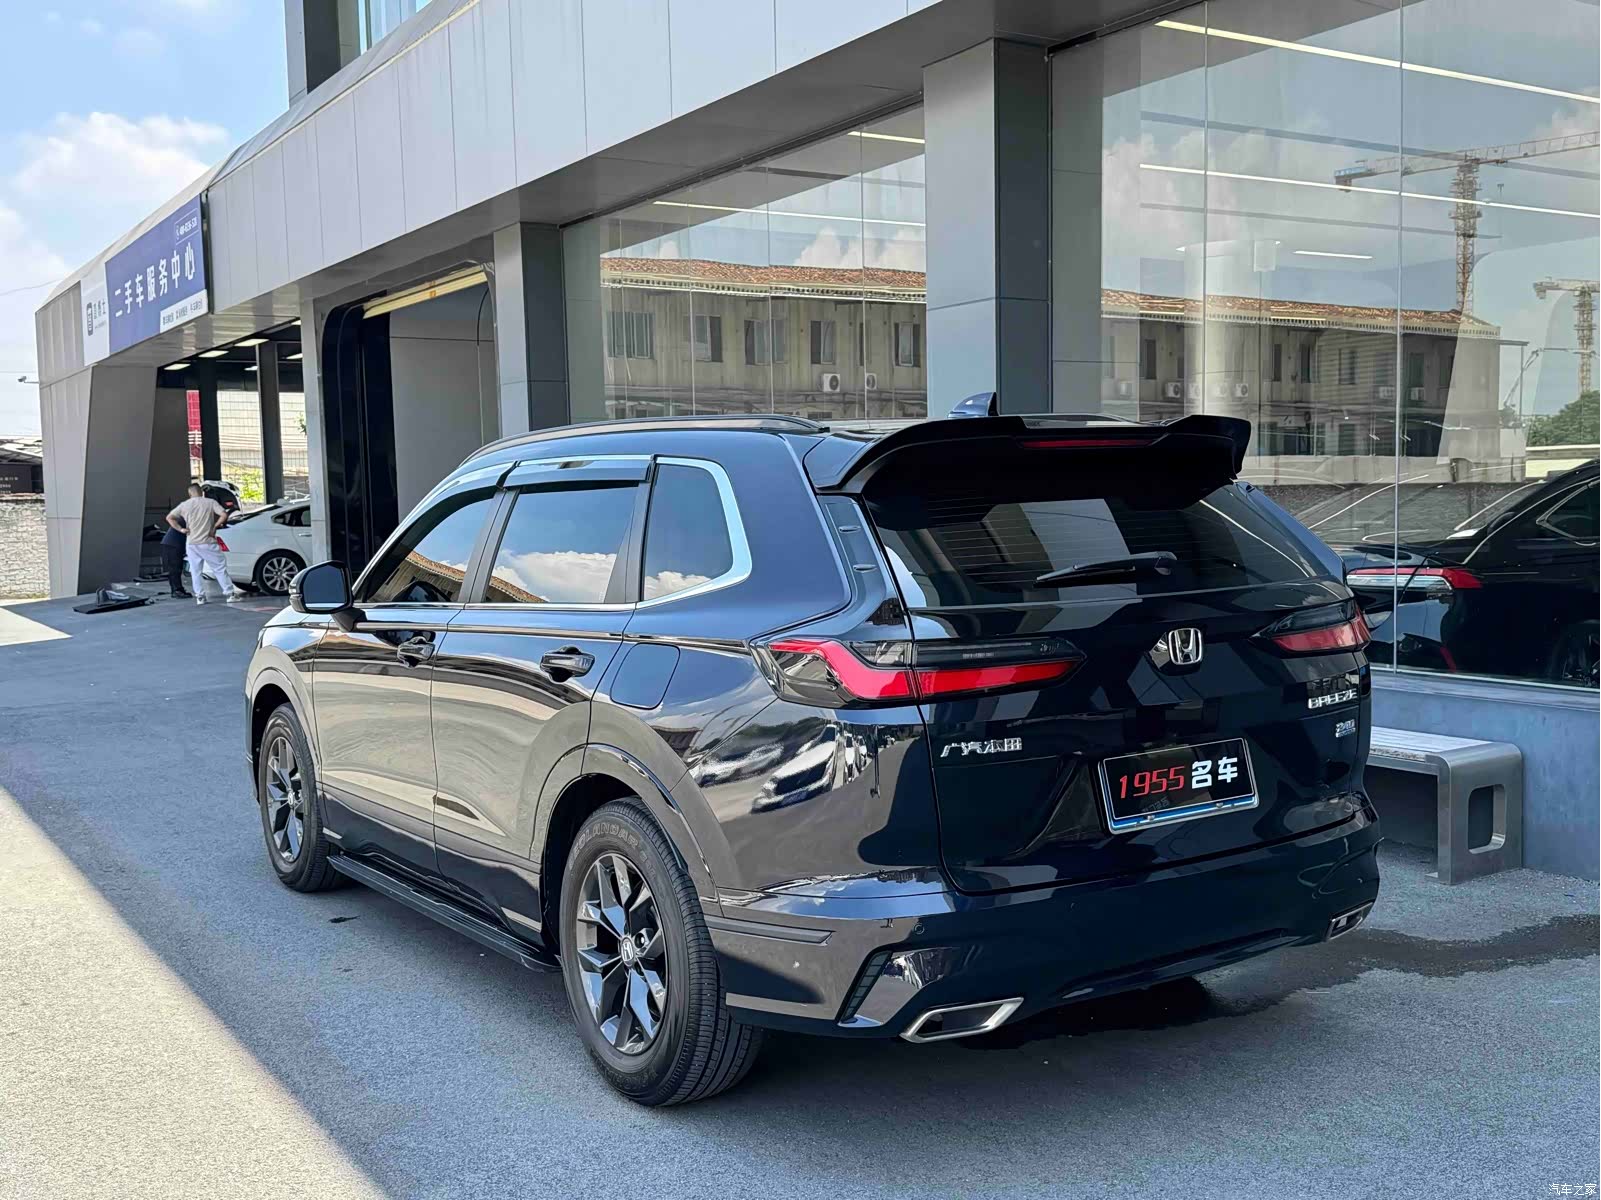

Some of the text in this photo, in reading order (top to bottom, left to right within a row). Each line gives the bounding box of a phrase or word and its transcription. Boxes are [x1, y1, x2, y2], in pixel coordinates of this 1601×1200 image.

[114, 242, 196, 318] 二手车服务中心
[1307, 688, 1358, 709] BREEZE
[940, 737, 1023, 758] 广汽本田
